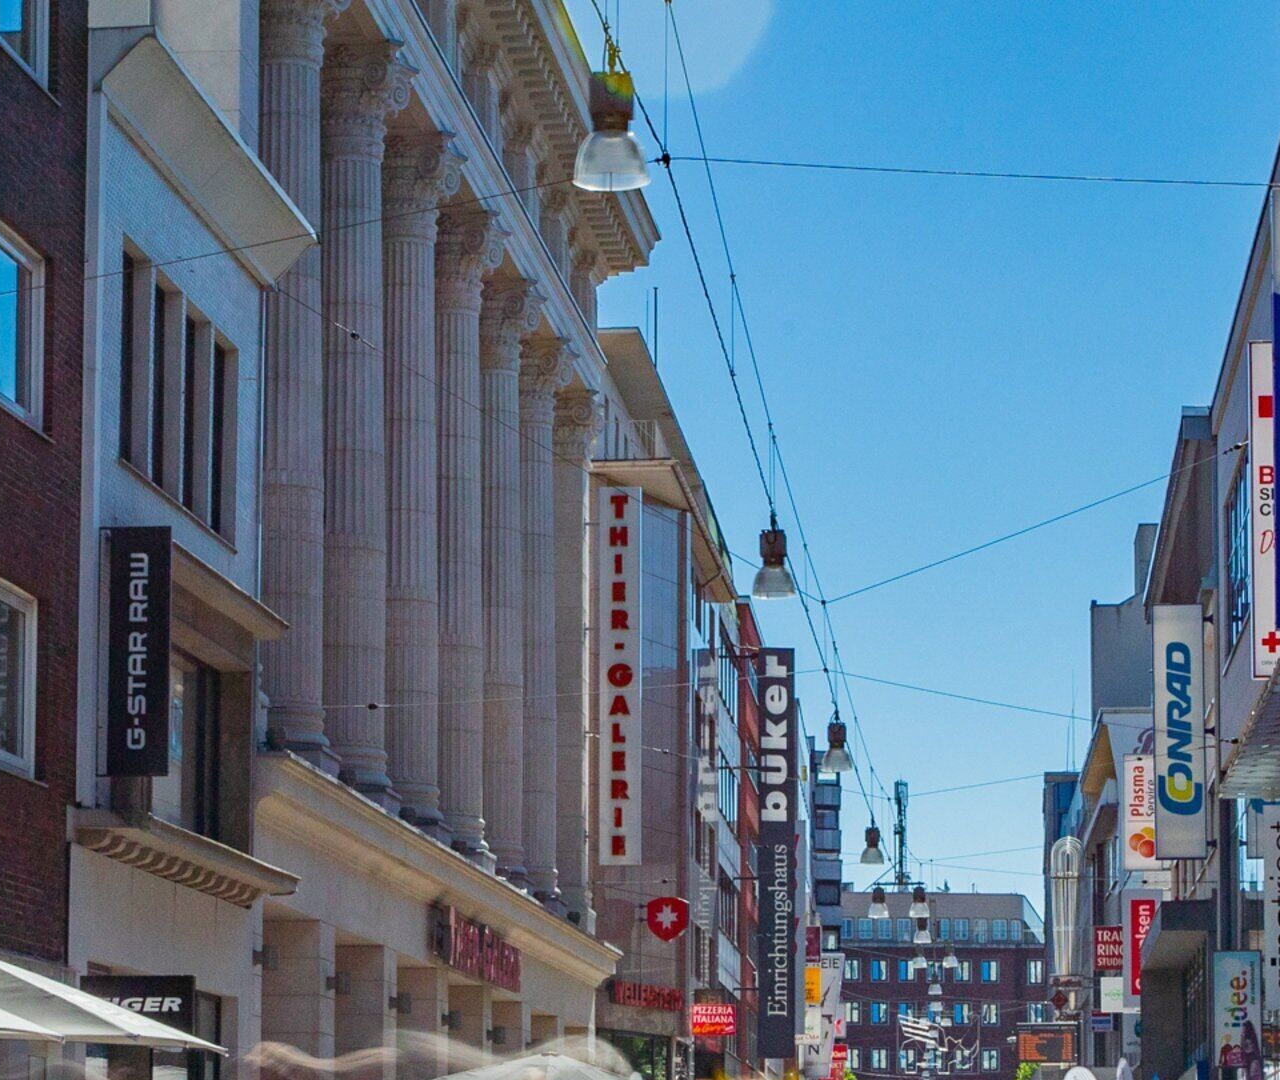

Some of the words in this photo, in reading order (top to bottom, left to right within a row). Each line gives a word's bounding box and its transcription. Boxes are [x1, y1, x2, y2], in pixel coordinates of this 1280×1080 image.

[128, 552, 150, 623] RAW
[126, 631, 148, 750] G-STAR
[1158, 641, 1203, 816] CONRAD
[1129, 764, 1145, 818] Plasma
[766, 844, 793, 1018] Einrichtungshaus
[693, 1005, 733, 1015] PIZZERIA
[693, 1015, 734, 1024] ITALIANA
